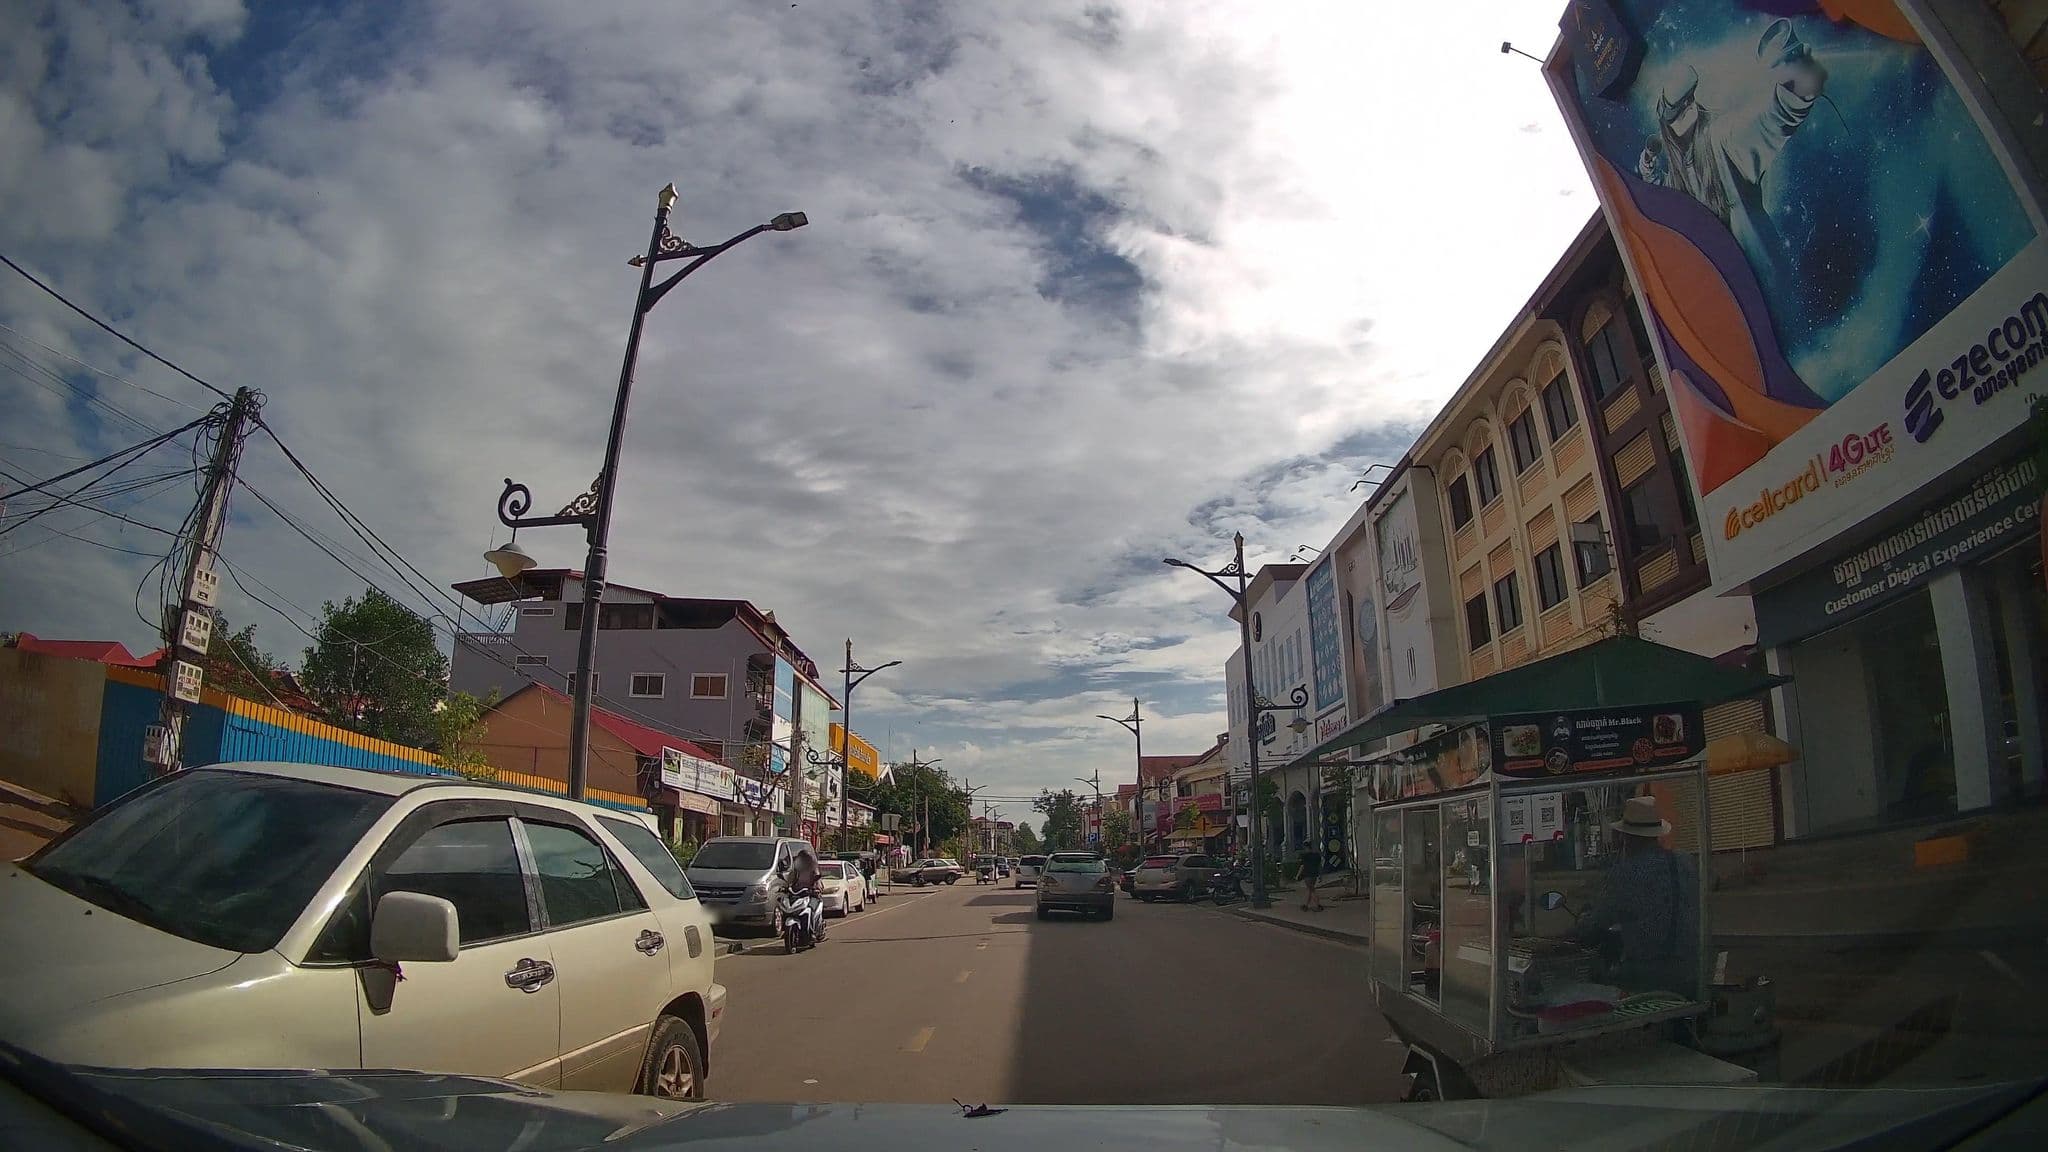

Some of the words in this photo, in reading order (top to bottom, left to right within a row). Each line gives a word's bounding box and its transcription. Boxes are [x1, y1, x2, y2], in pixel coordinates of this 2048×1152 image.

[1937, 292, 2048, 400] ezecom
[1741, 459, 1820, 529] cellcard
[1825, 581, 1886, 615] Customer
[1887, 555, 1930, 588] Digital
[1933, 518, 2013, 566] Experience
